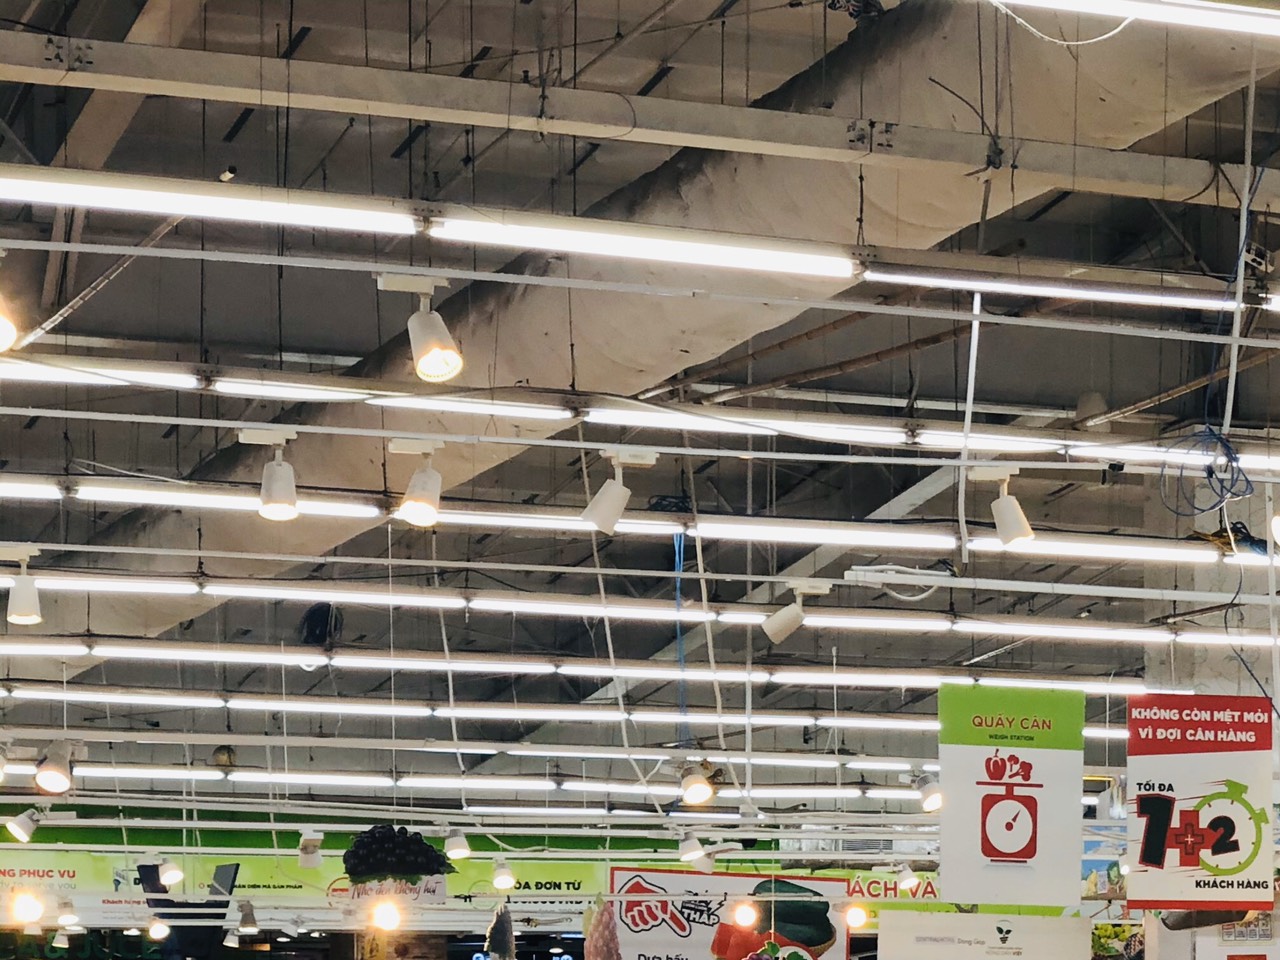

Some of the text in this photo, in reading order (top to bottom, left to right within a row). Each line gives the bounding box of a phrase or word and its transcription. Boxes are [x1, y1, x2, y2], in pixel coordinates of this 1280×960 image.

[1131, 707, 1180, 721] KHÔNG
[1182, 707, 1211, 722] CÒN
[1213, 709, 1242, 724] MỆT
[1020, 716, 1052, 730] CÂN
[1138, 725, 1256, 743] VÌ ĐỢI CÂN HÀNG
[1136, 780, 1175, 793] TỐI ĐA
[535, 881, 562, 890] ĐƠN
[1195, 877, 1269, 891] KHÁCH HÀNG
